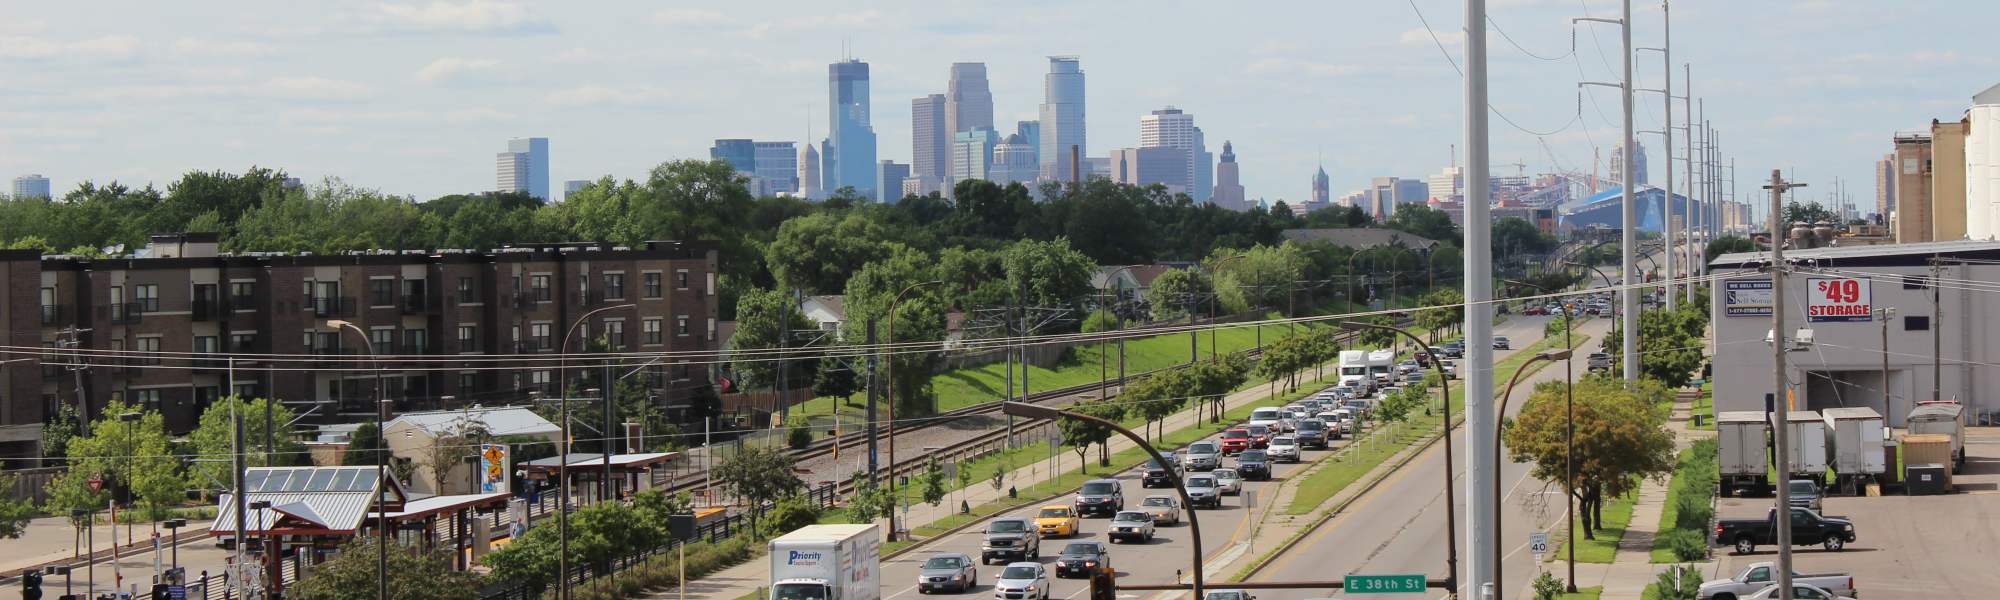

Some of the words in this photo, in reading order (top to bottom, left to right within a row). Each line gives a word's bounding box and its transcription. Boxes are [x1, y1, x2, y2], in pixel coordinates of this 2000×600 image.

[1818, 280, 1859, 303] $49
[1810, 305, 1869, 315] STORAGE
[1532, 543, 1546, 551] 40
[788, 551, 821, 565] Priority
[1350, 579, 1359, 590] E
[1366, 579, 1398, 589] 38th
[1406, 579, 1419, 589] St
